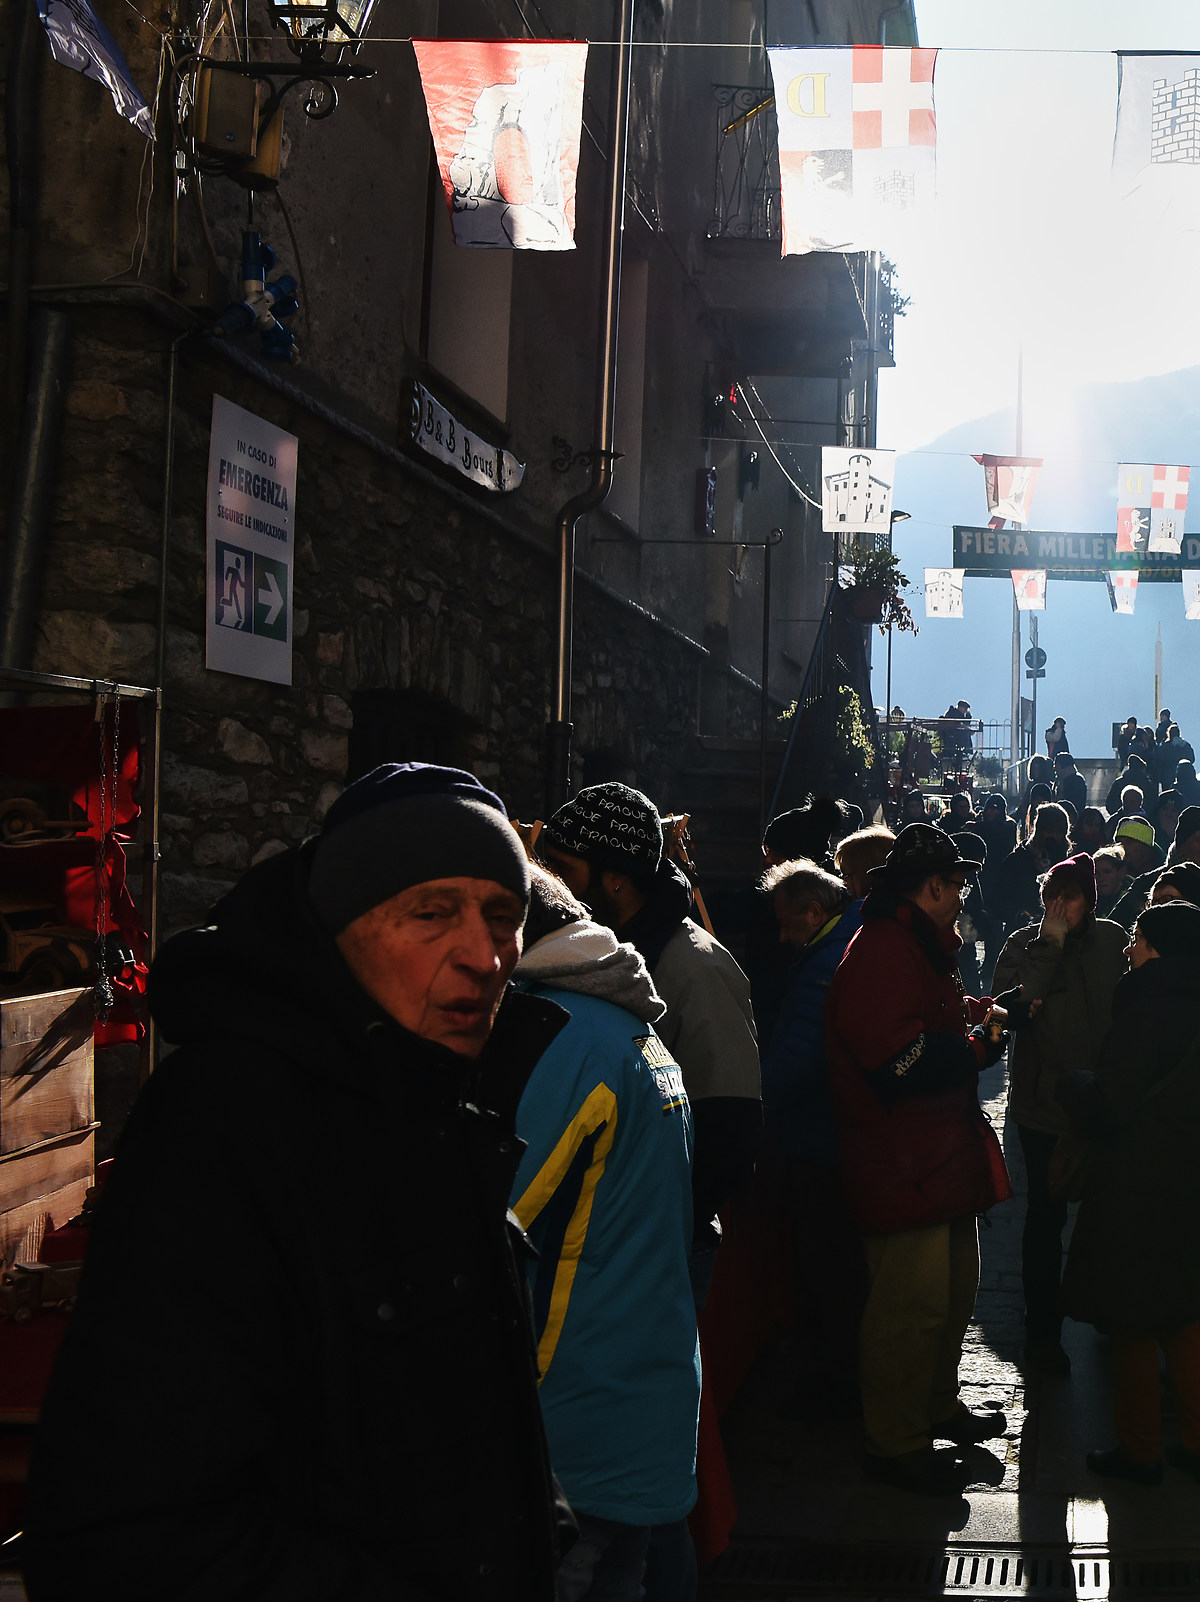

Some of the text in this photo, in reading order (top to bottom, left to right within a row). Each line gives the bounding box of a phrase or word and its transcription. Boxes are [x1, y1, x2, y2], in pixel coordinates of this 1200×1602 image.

[237, 440, 277, 469] IN CASO DI
[462, 436, 494, 479] Bours
[219, 458, 288, 511] EMERGENZA
[217, 504, 288, 542] SEGUIRE LE INDICAZIONI
[960, 531, 1029, 557] FIERA
